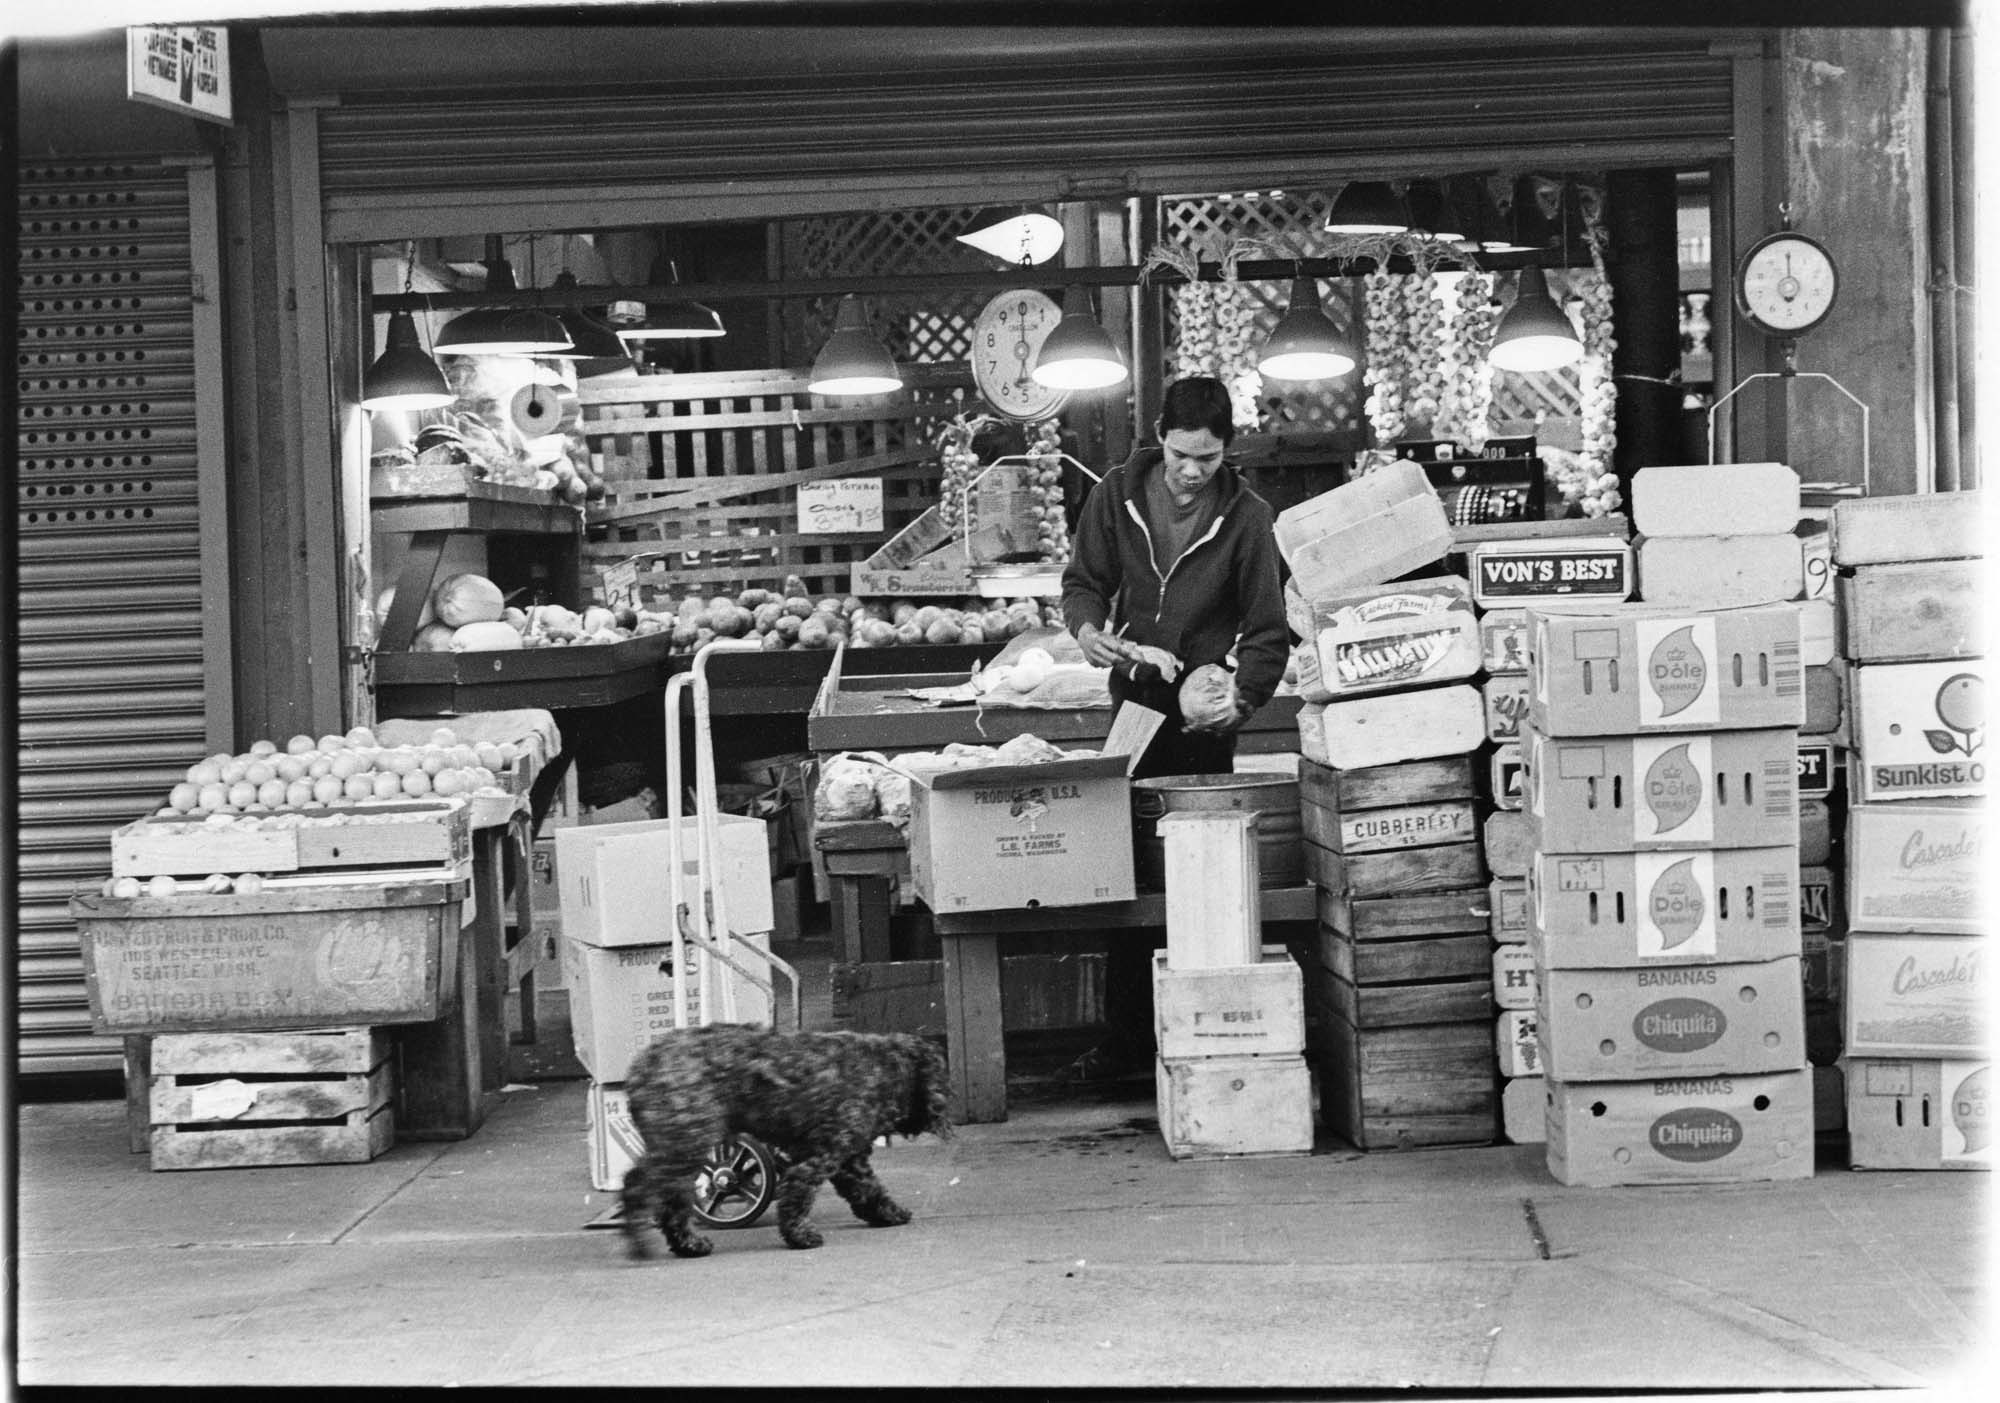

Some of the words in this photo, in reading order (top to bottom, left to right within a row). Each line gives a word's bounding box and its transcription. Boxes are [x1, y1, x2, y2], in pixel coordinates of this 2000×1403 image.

[1484, 561, 1554, 583] VON'S
[1560, 559, 1618, 581] BEST
[1807, 556, 1829, 598] 9
[1024, 840, 1062, 850] FARMS
[1638, 970, 1717, 987] BANANAS
[1893, 955, 1967, 996] Cascade
[1642, 1013, 1717, 1038] Chiquita
[1654, 1079, 1734, 1096] BANANAS
[1658, 1122, 1734, 1148] Chiquita
